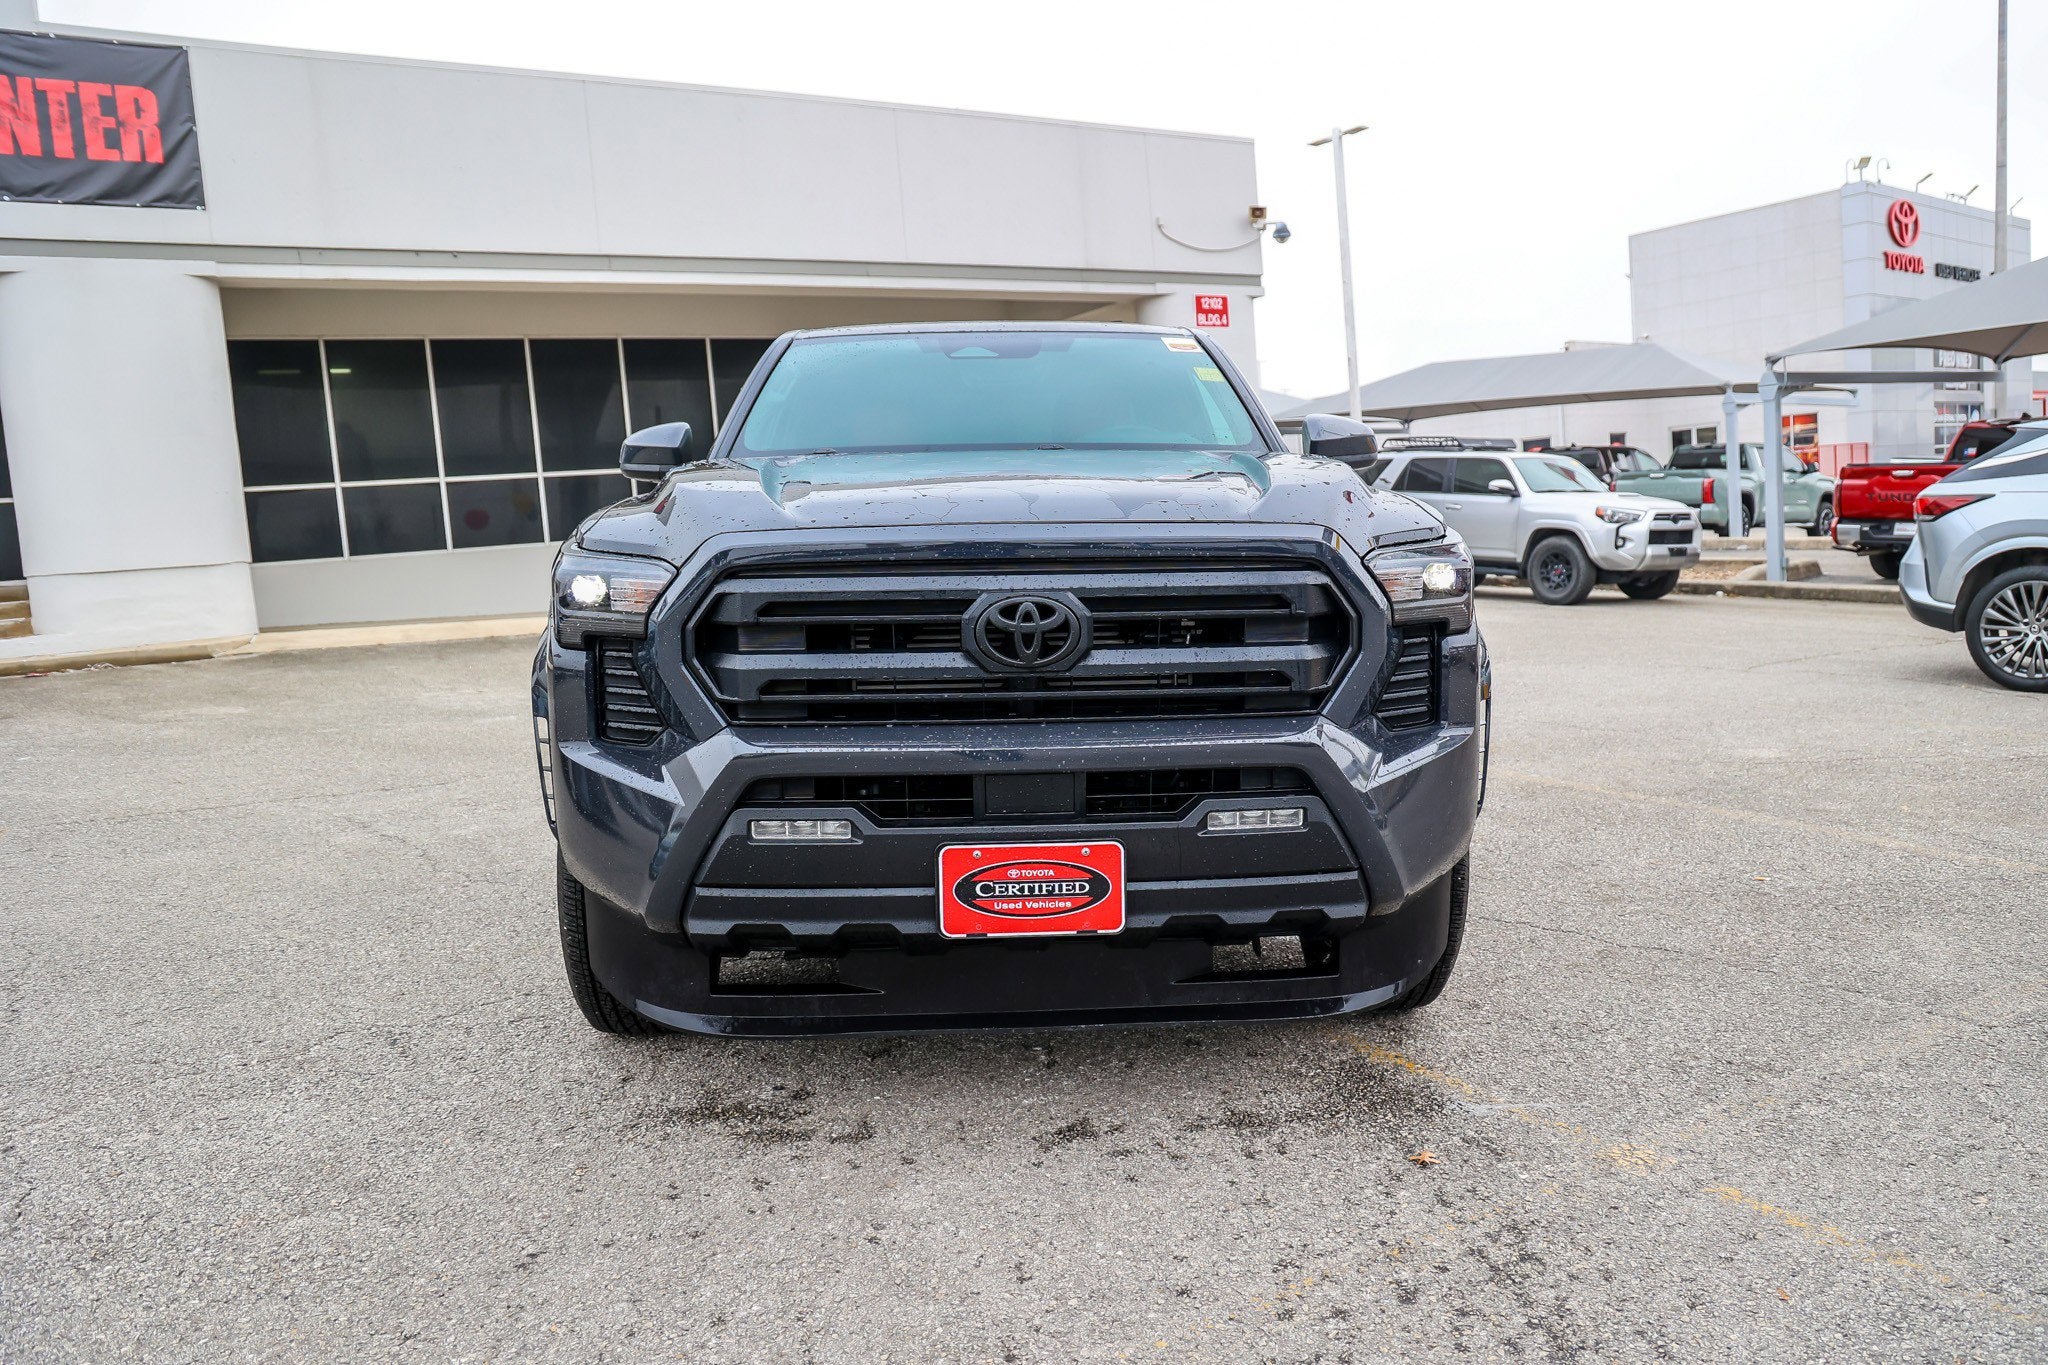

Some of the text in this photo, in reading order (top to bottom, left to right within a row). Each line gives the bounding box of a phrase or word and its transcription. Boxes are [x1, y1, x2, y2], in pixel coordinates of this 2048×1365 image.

[0, 75, 164, 164] NTER
[1883, 251, 1925, 274] TOYOTA
[1021, 869, 1055, 877] TOYOTA
[994, 900, 1072, 910] Used Vehicles
